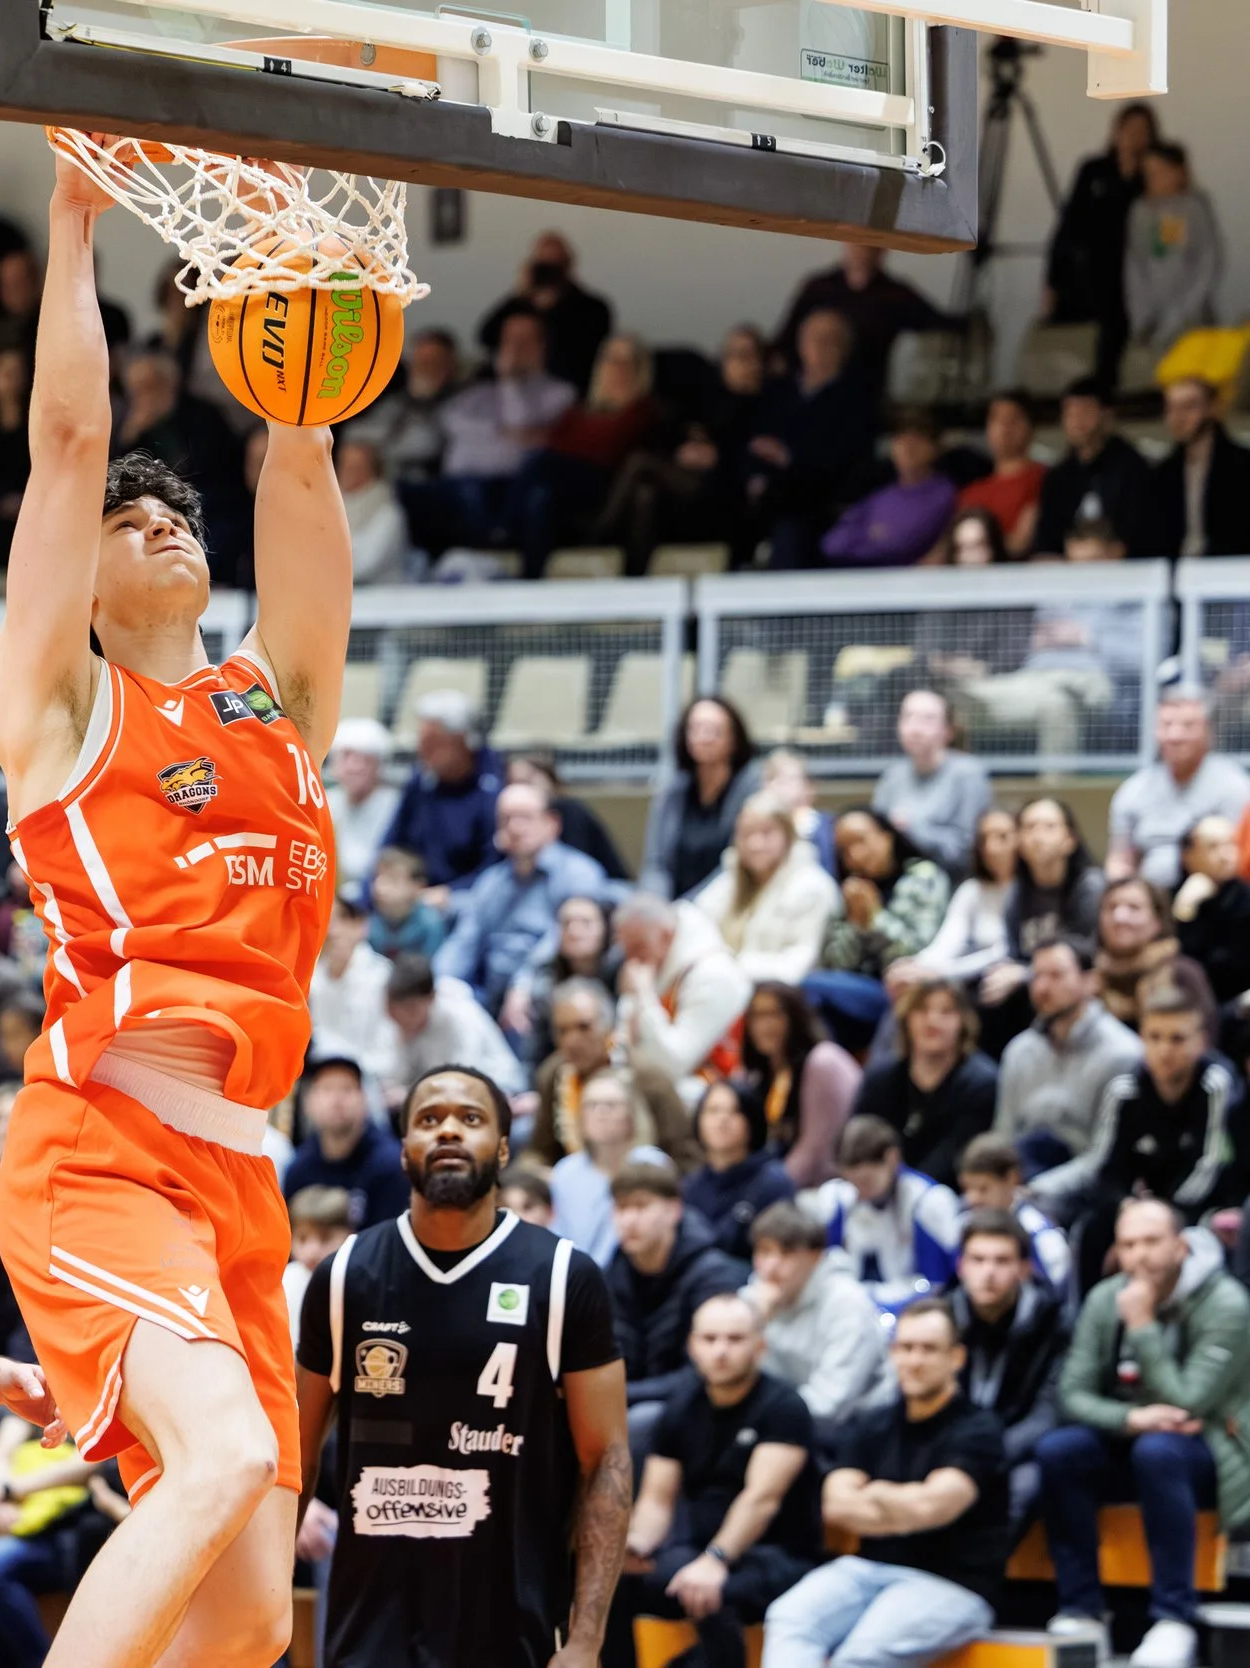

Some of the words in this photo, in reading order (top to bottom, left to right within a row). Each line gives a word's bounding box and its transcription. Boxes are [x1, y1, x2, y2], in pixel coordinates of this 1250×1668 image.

[262, 292, 289, 371] EVO
[276, 370, 287, 393] NXT
[317, 271, 364, 398] Wilson
[286, 743, 324, 809] 16
[167, 786, 217, 803] DRAGONS
[357, 1379, 400, 1391] MINERS
[476, 1342, 518, 1409] 4
[448, 1421, 524, 1456] Stauder
[371, 1478, 467, 1499] AUSBILDUNGS-
[366, 1500, 467, 1521] offensive
